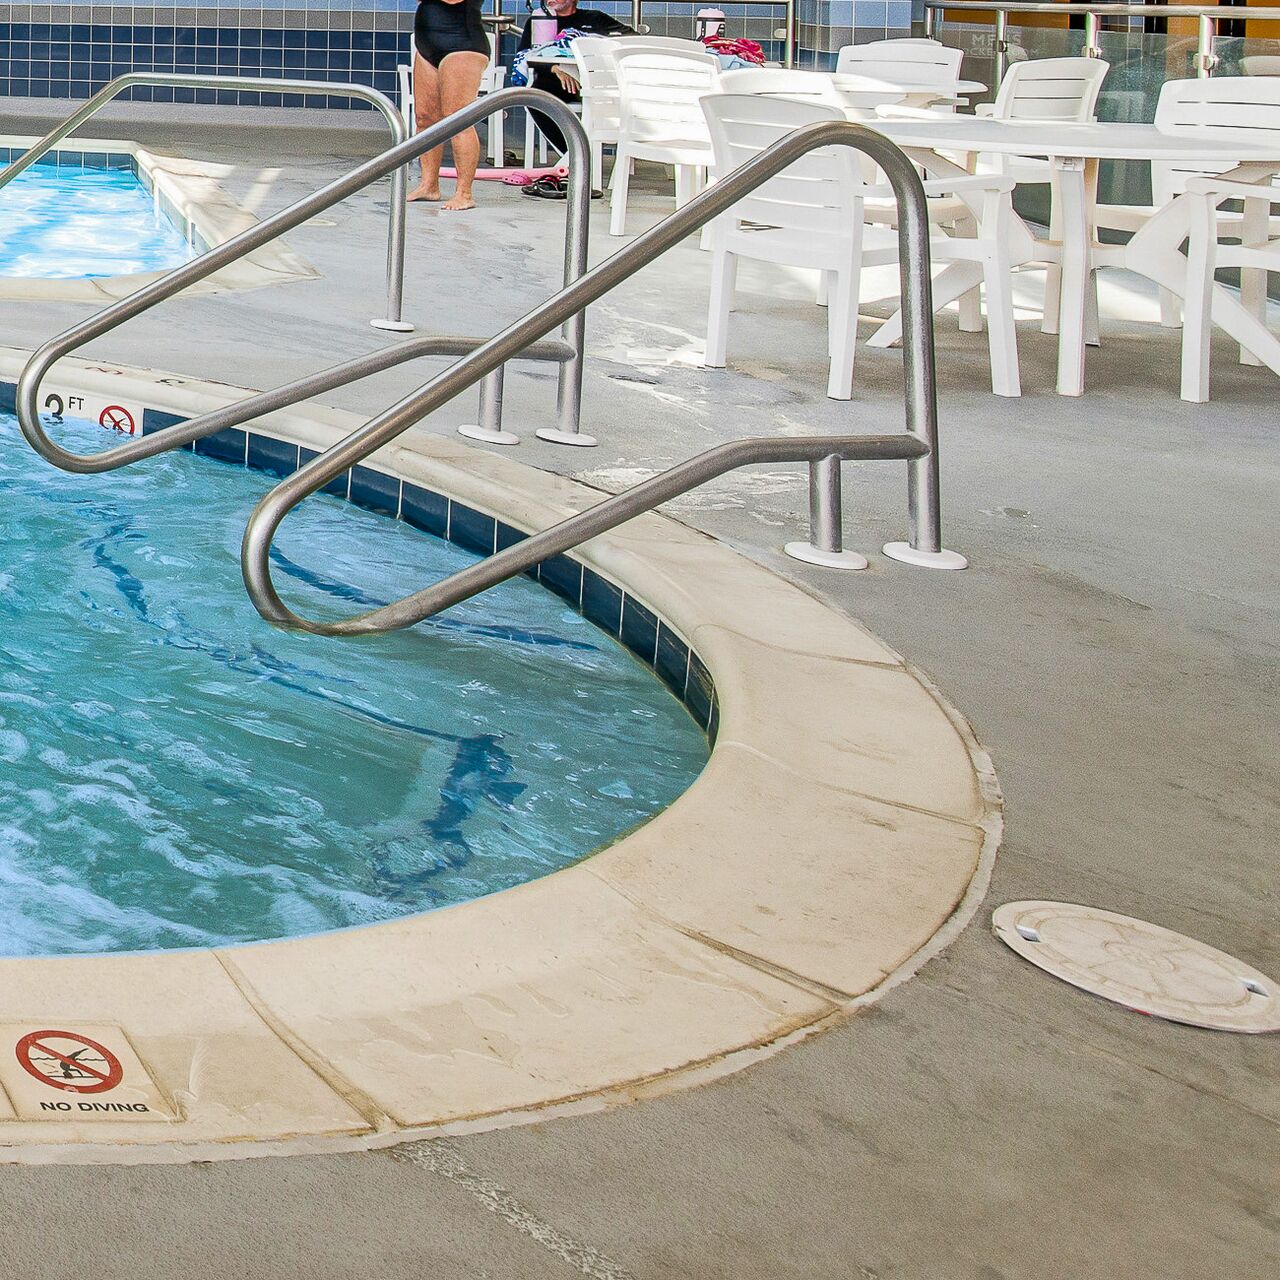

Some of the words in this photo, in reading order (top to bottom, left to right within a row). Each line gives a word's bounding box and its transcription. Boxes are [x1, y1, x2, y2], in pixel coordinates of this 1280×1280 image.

[68, 396, 85, 411] FT
[40, 1101, 72, 1112] NO
[77, 1102, 150, 1113] DIVING
